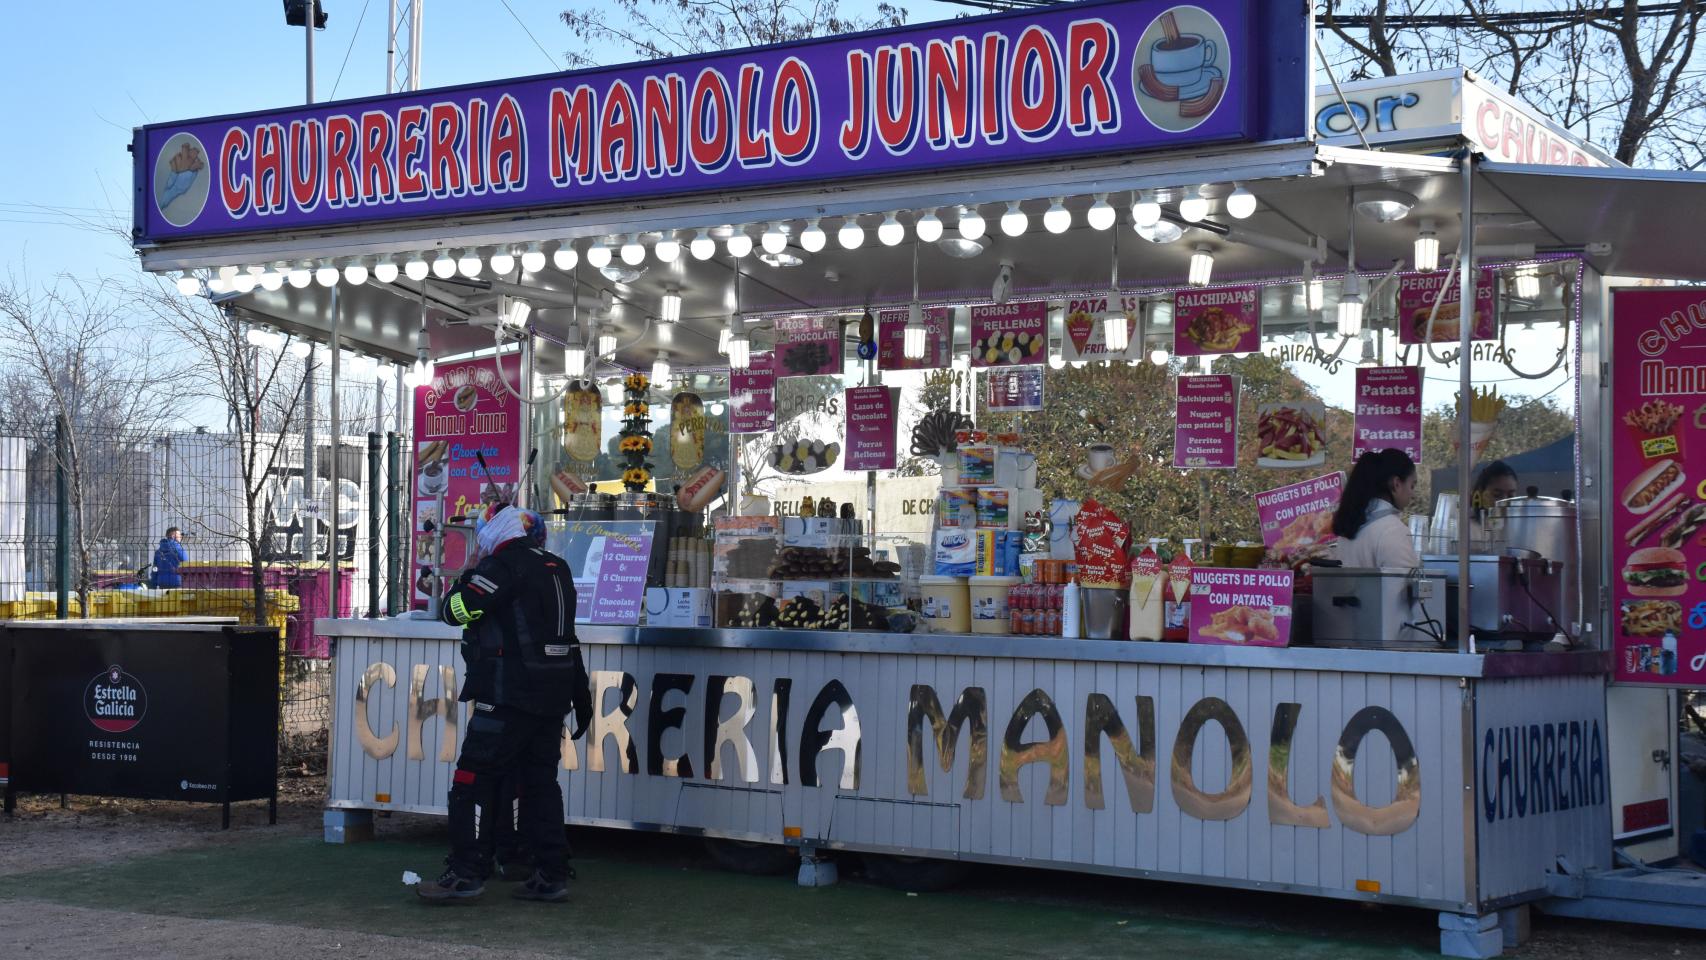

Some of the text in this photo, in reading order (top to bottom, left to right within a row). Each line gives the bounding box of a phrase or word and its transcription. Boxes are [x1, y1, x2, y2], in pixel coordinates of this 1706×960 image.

[220, 18, 1121, 219] CHURRERIA MANOLO JUNIOR
[1177, 290, 1256, 308] SALCHIPAPAS
[1422, 287, 1492, 303] CALIEES
[973, 305, 1020, 317] PORRAS
[776, 319, 824, 332] LAZOS DE
[983, 318, 1041, 331] RELLENAS
[789, 331, 839, 343] CHOCOLATE
[1361, 385, 1416, 396] Patatas
[781, 394, 839, 416] ORRAS
[854, 401, 884, 410] Lazos de
[1177, 394, 1224, 405] Salchipapas
[1189, 410, 1222, 420] Nuggets
[1357, 404, 1402, 416] Fritas
[851, 412, 888, 421] Chocolate
[425, 408, 508, 438] MANOLO JUNIOR
[1194, 420, 1224, 431] patatas
[1188, 436, 1222, 445] Perritos
[1359, 429, 1416, 440] Patatas
[857, 439, 883, 448] Porras
[451, 444, 499, 466] Chocolate
[853, 450, 886, 459] Rellenas
[450, 460, 512, 482] con Churros
[1258, 476, 1340, 508] NUGGETS DE POLLO
[1275, 497, 1330, 521] CON PATATAS
[604, 553, 647, 561] 12 Churros
[610, 574, 642, 582] Churros
[1193, 572, 1291, 588] NUGGETS DE POLLO
[599, 597, 636, 606] Chocolate
[1209, 593, 1274, 607] CON PATATAS
[94, 684, 137, 701] Estrella
[95, 700, 135, 716] Galicia
[89, 740, 141, 750] RESISTENCIA
[355, 661, 1422, 837] CHRERIA MANOLO
[1483, 719, 1605, 824] CHURRERIA
